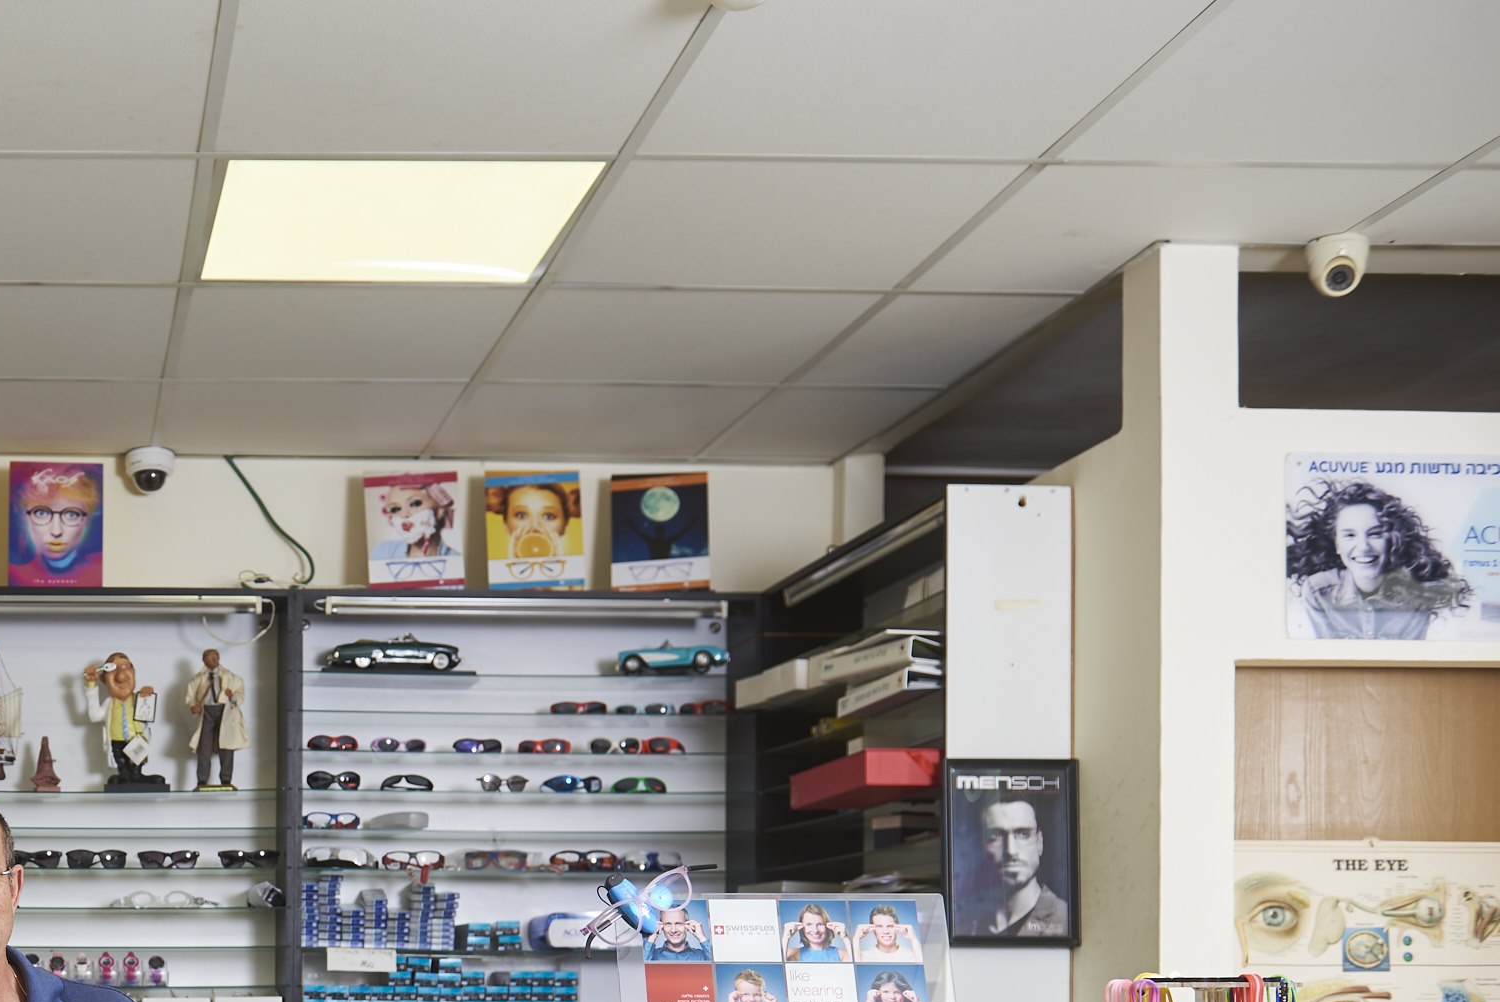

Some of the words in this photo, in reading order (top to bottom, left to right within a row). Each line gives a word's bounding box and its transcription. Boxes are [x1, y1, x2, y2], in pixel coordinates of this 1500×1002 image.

[1308, 461, 1369, 473] ACUVUE
[1375, 462, 1405, 474] מגע
[1409, 463, 1461, 475] עדשות
[1463, 525, 1500, 544] AC
[1333, 859, 1368, 871] THE
[1375, 859, 1408, 871] EYE
[790, 968, 810, 982] like
[792, 984, 844, 999] wearing
